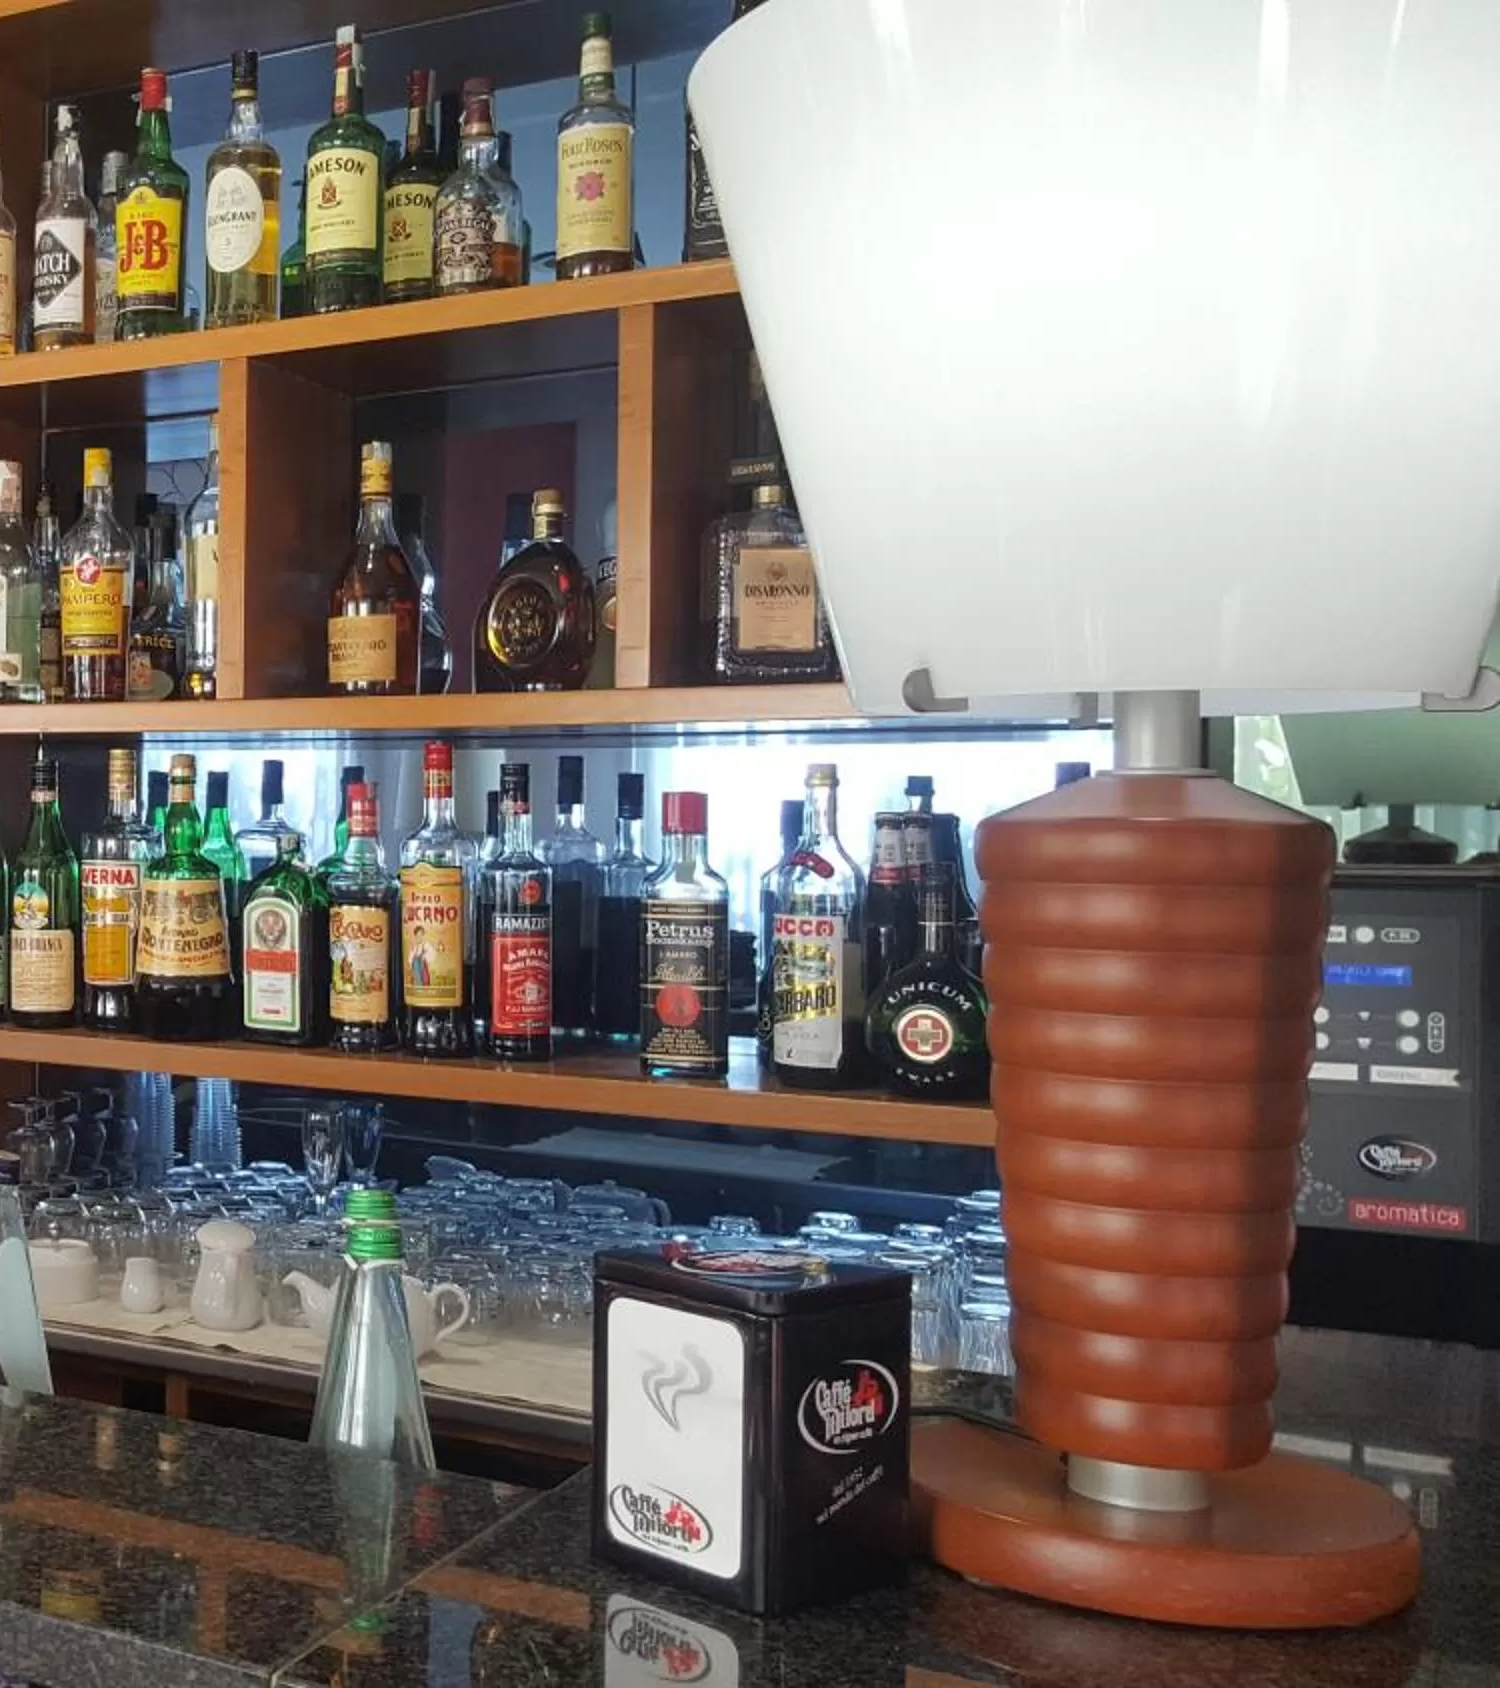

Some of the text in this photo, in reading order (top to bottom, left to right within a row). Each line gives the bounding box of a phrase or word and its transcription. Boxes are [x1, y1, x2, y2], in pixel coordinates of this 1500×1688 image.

[744, 583, 810, 599] DISARONNO
[646, 920, 715, 939] Petrus
[887, 981, 972, 1011] UNICUM
[1355, 1202, 1460, 1227] aromatica
